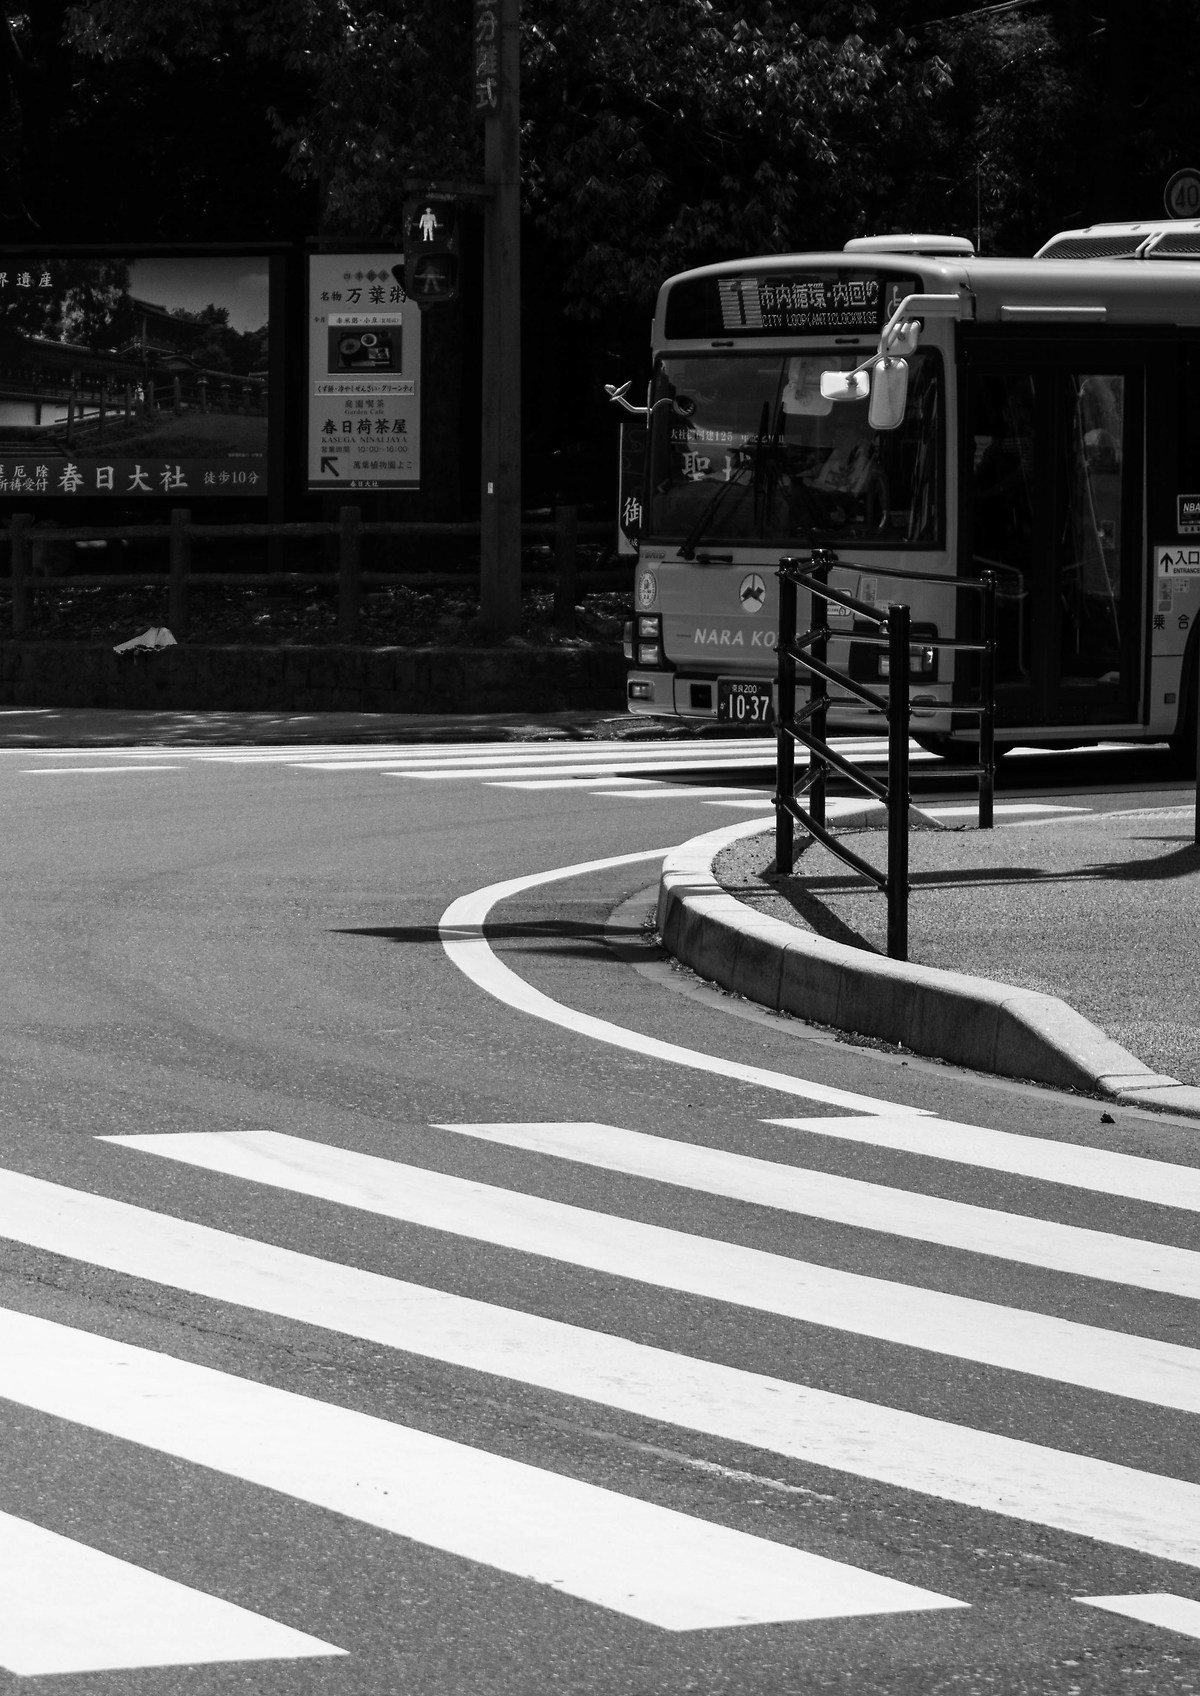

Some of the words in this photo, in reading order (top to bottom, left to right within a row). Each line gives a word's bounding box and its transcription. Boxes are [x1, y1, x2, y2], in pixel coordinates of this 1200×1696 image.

[475, 0, 497, 108] 分離式
[1175, 184, 1199, 207] 40
[320, 291, 342, 301] 名物
[762, 314, 782, 327] CITY
[321, 418, 408, 435] 春日荷茶屋
[57, 463, 189, 493] 春日大社
[203, 470, 260, 485] 徒歩10分
[1175, 550, 1200, 565] 入口
[694, 627, 745, 646] NARA
